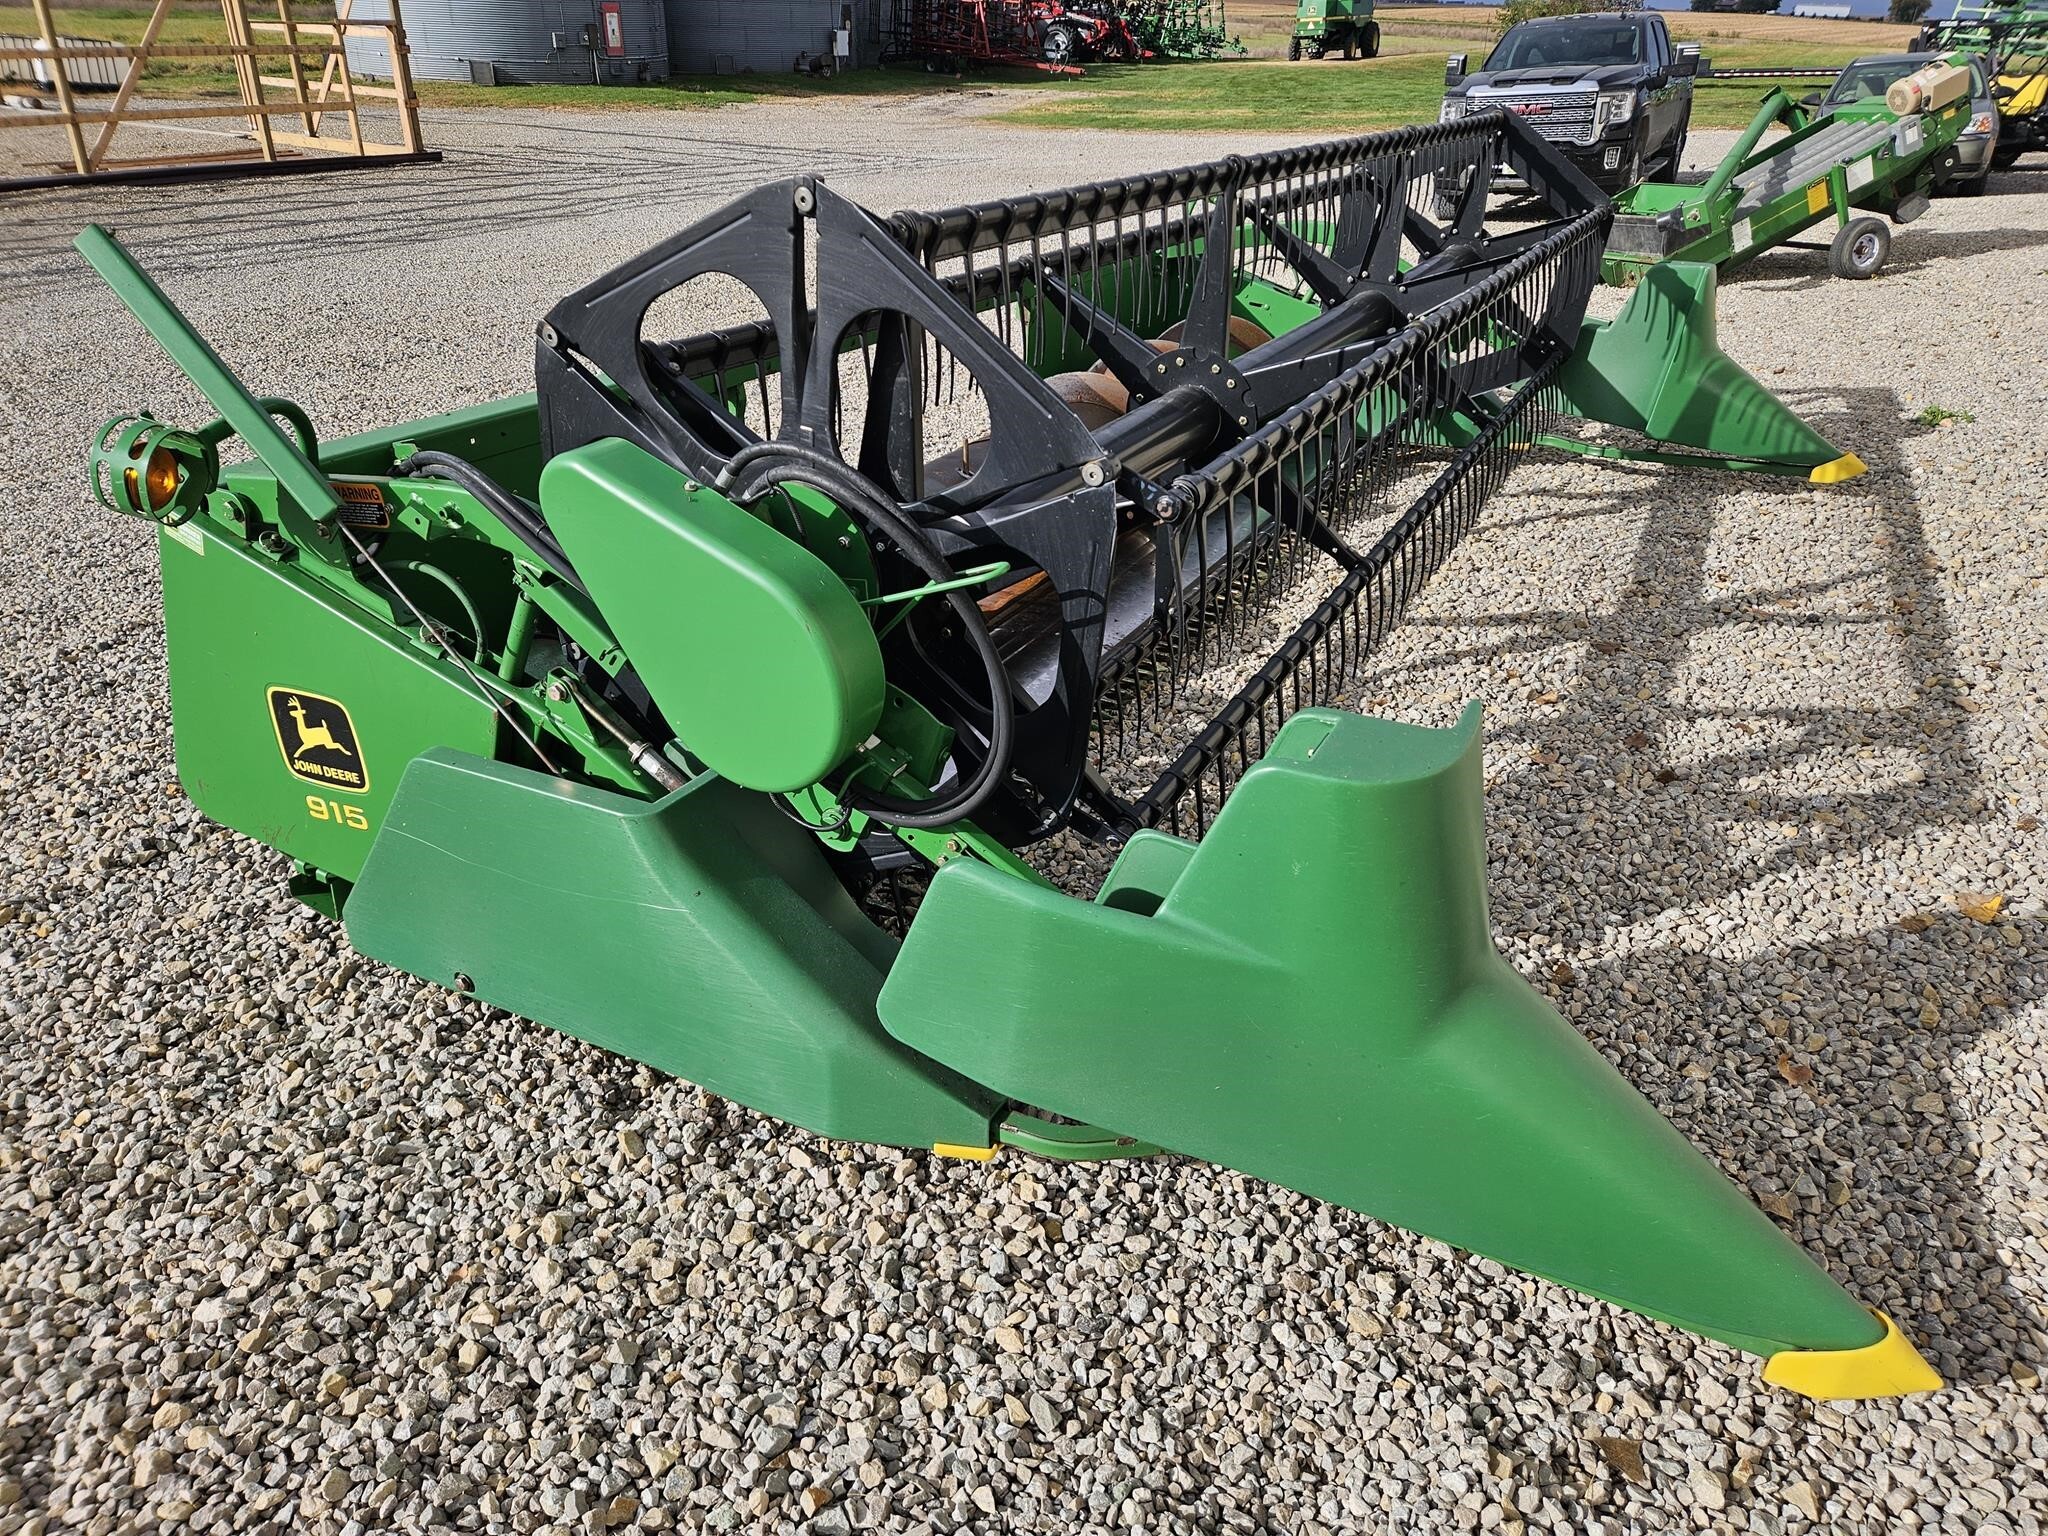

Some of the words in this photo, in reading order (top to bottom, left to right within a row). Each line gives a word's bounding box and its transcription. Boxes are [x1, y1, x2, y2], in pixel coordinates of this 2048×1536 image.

[293, 759, 323, 776] JOHN
[323, 766, 361, 784] DEERE
[305, 795, 369, 831] 915
